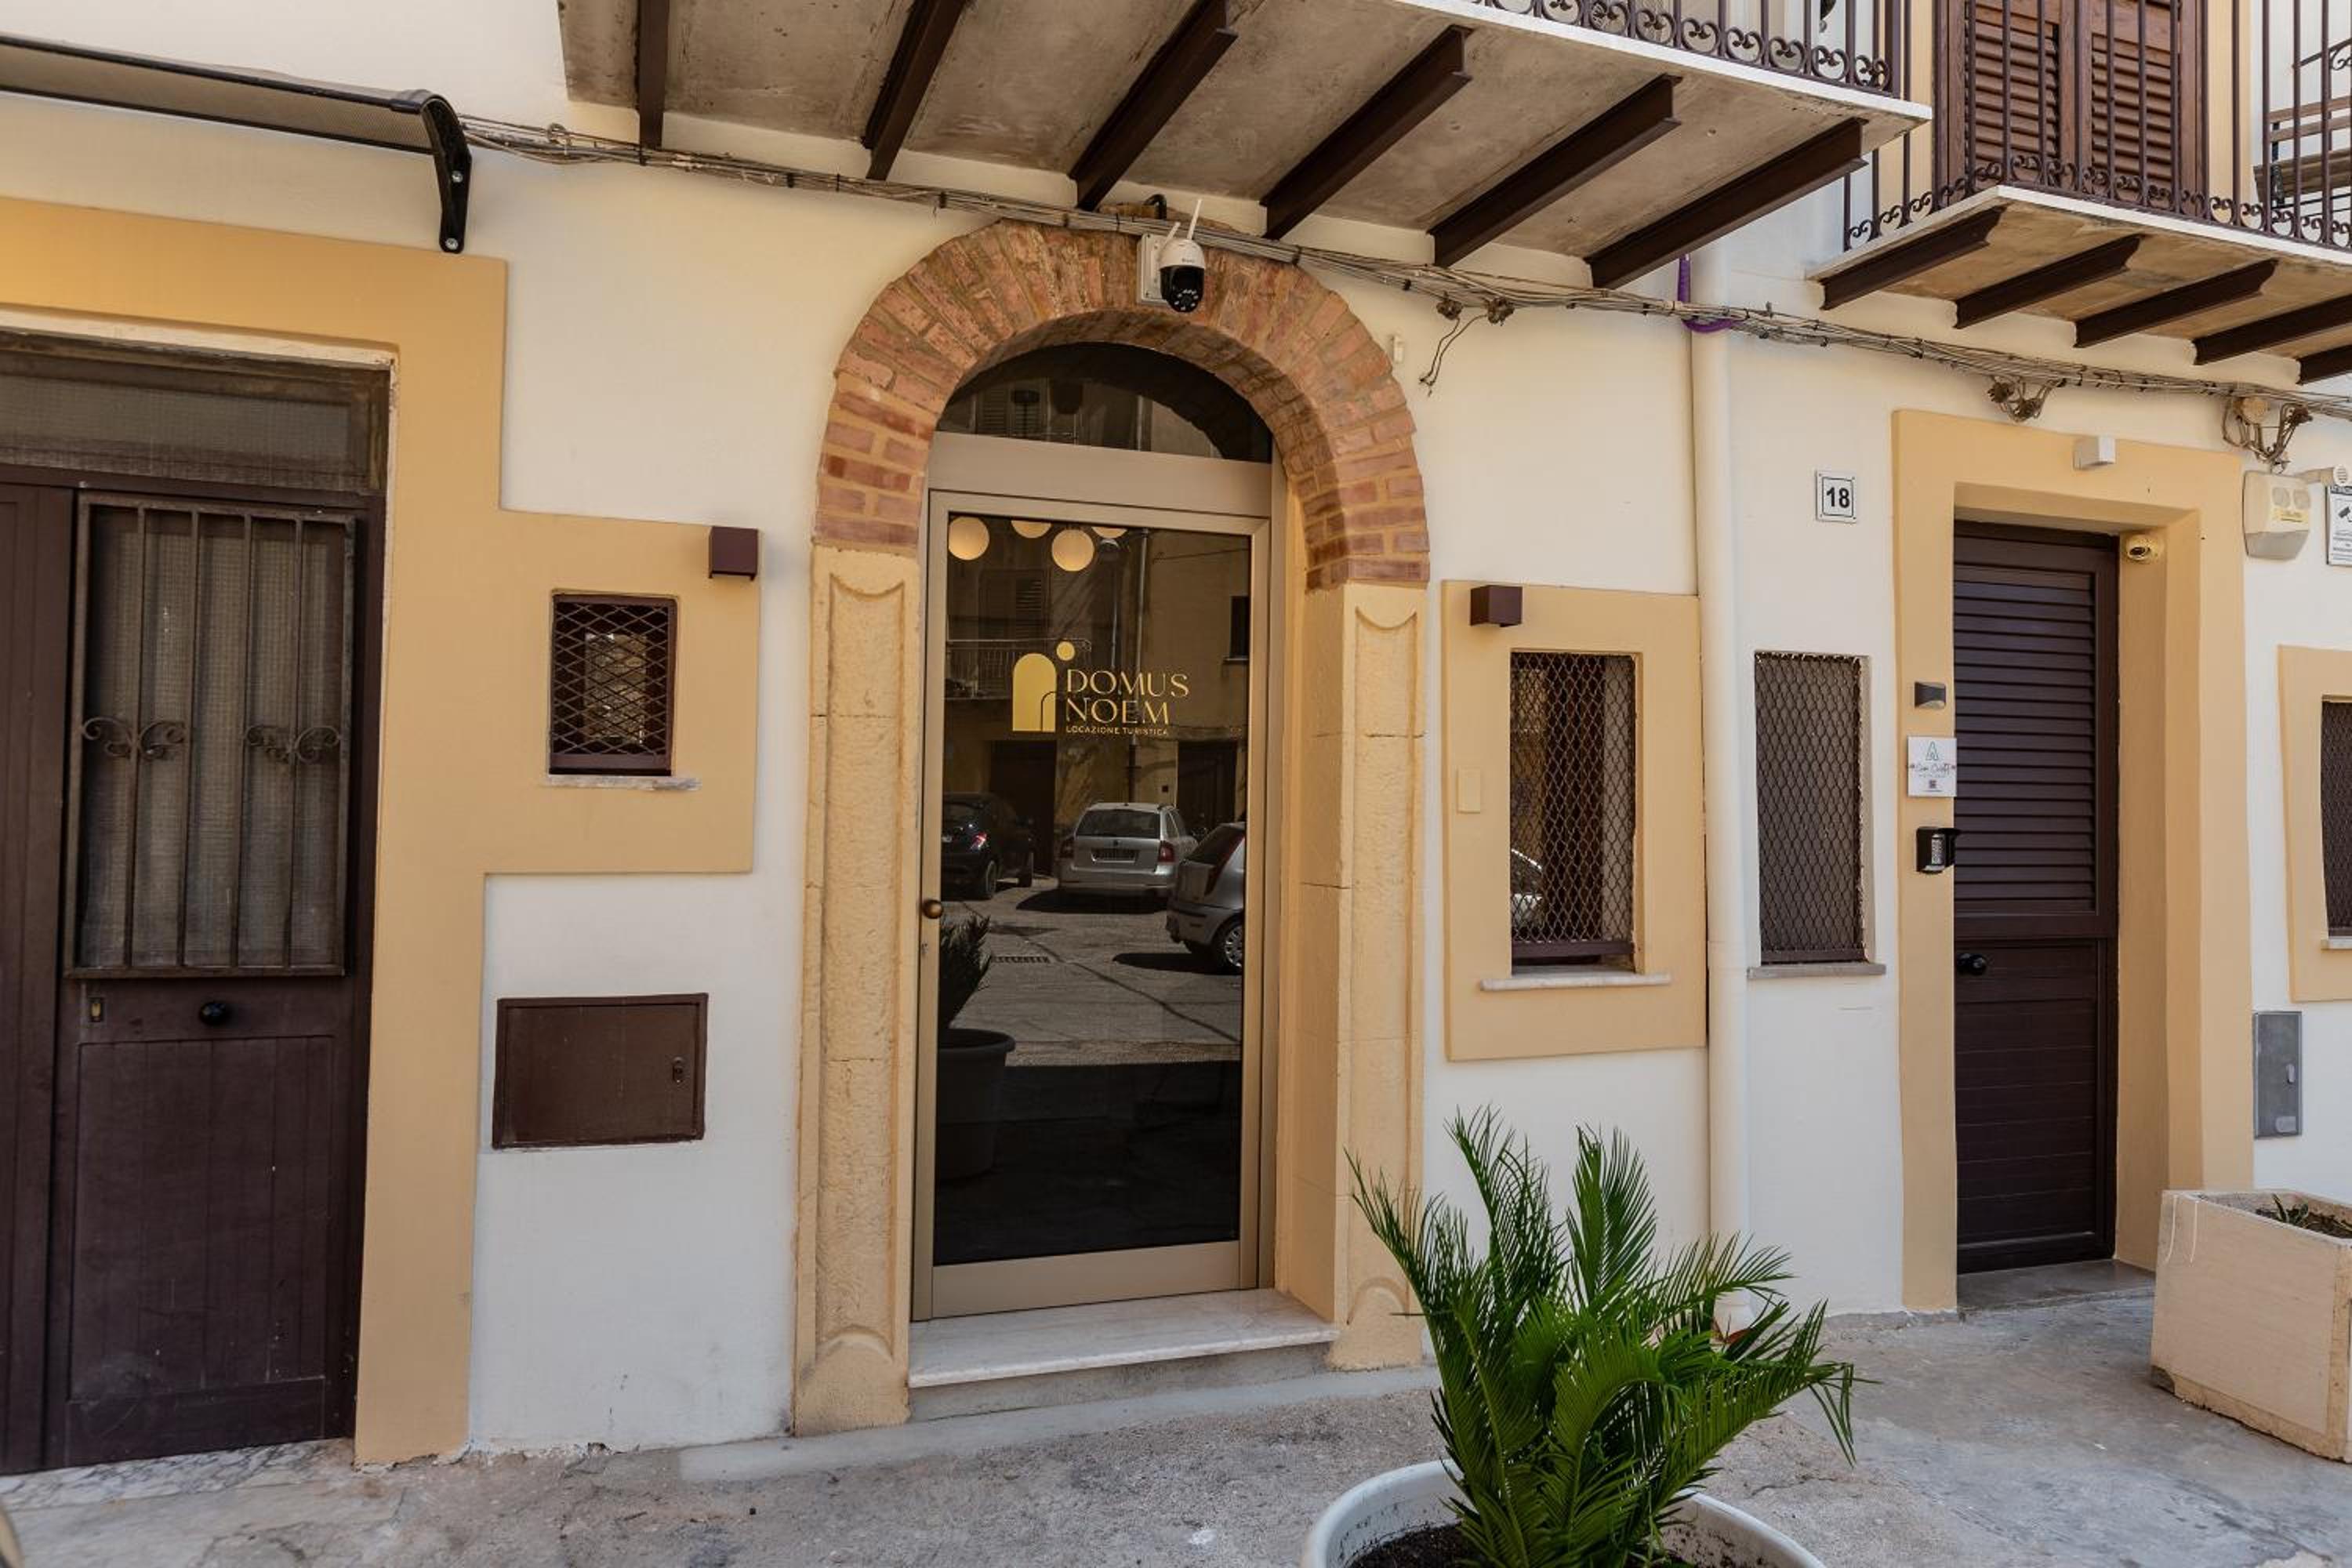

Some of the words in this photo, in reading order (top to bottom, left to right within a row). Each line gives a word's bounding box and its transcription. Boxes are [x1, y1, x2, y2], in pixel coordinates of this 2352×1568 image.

[1826, 487, 1850, 509] 18
[1066, 669, 1189, 697] DOMUS
[1065, 697, 1169, 724] NOEM
[1065, 725, 1120, 735] LOCAZIONE
[1123, 727, 1168, 735] TURISTICA
